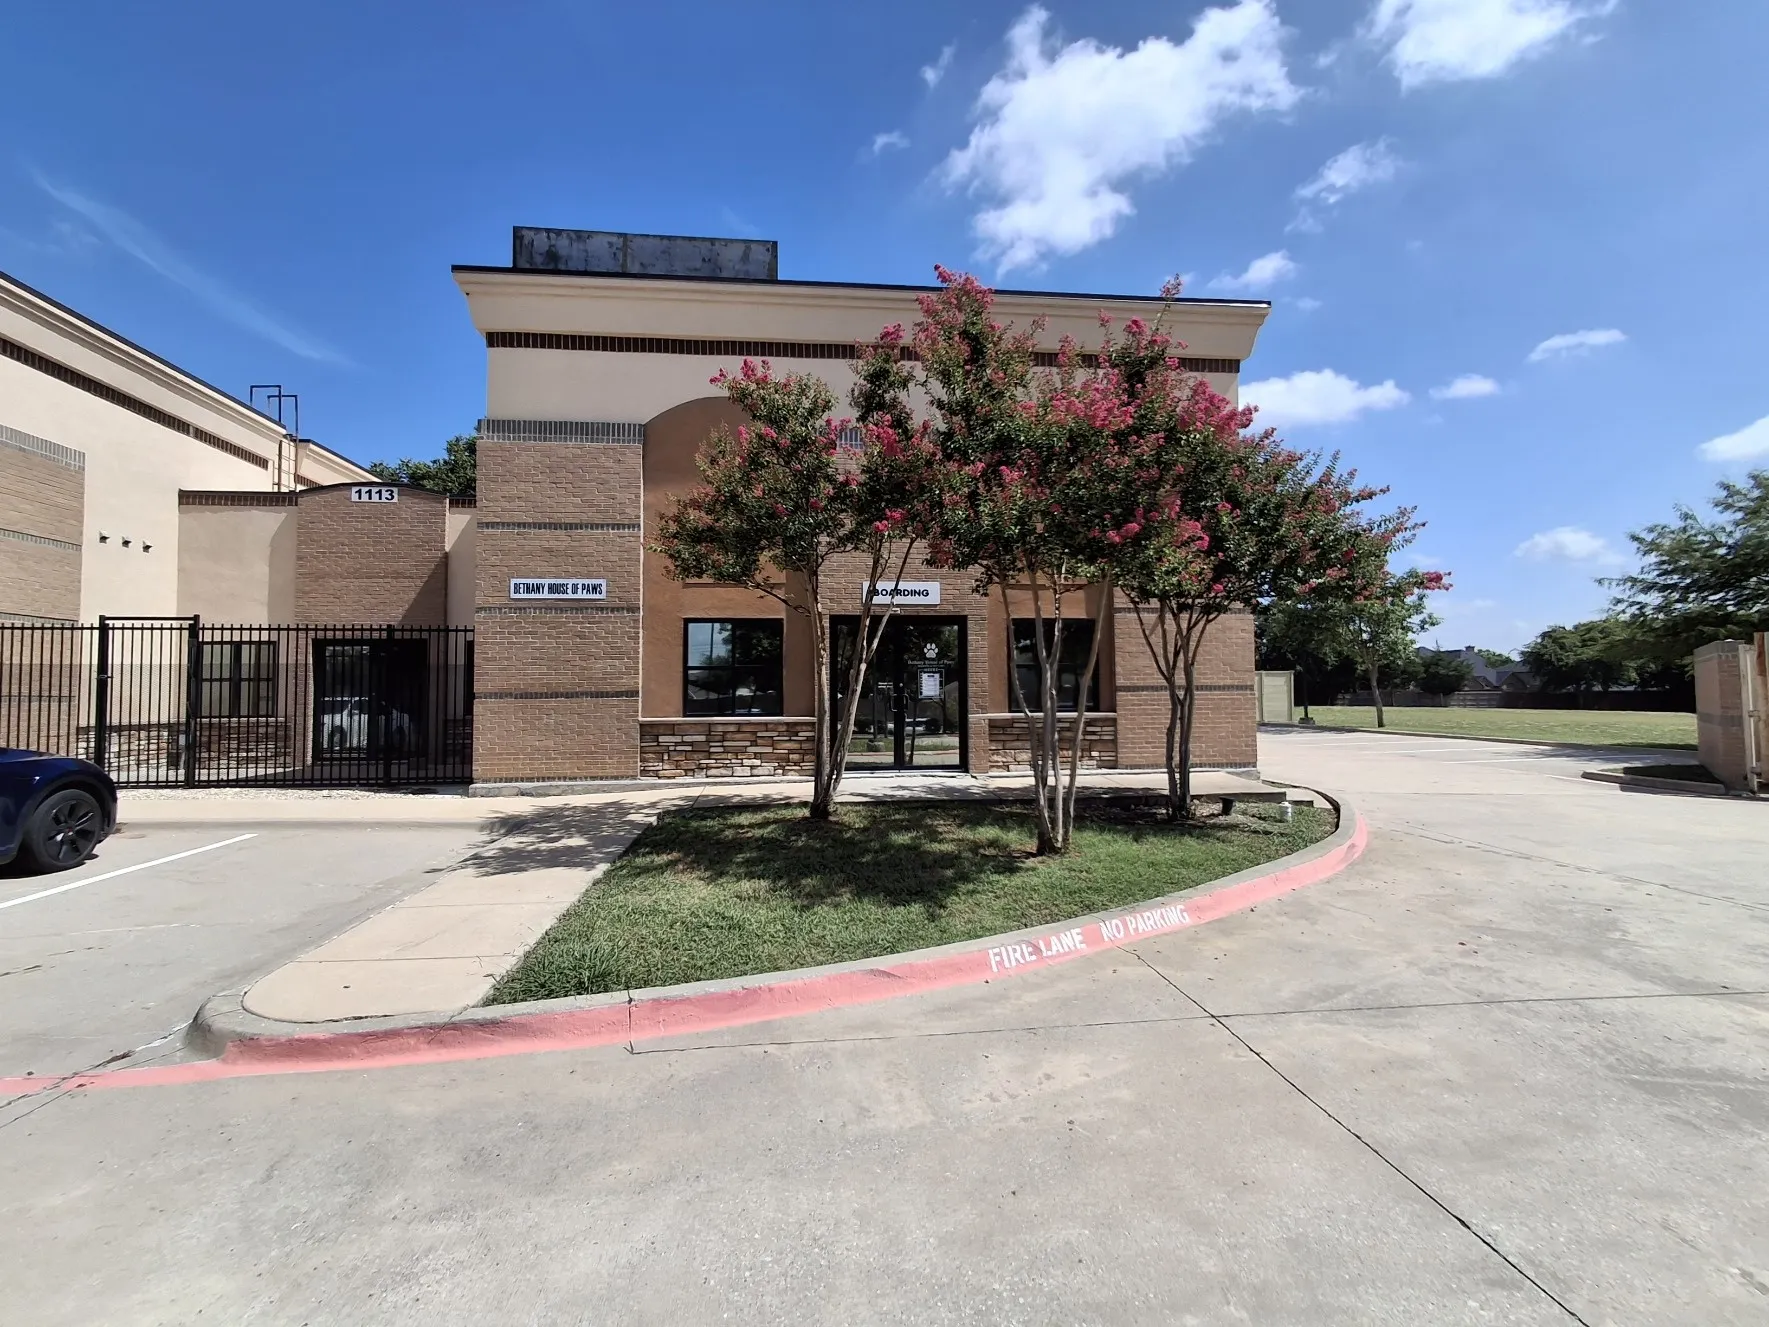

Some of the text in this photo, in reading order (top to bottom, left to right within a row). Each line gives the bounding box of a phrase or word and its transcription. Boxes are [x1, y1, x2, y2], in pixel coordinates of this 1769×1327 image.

[355, 488, 395, 501] 1113
[513, 582, 603, 595] BETHANY HOUSE OF PAWS
[987, 905, 1190, 973] FIRE LANE NO PARKING
